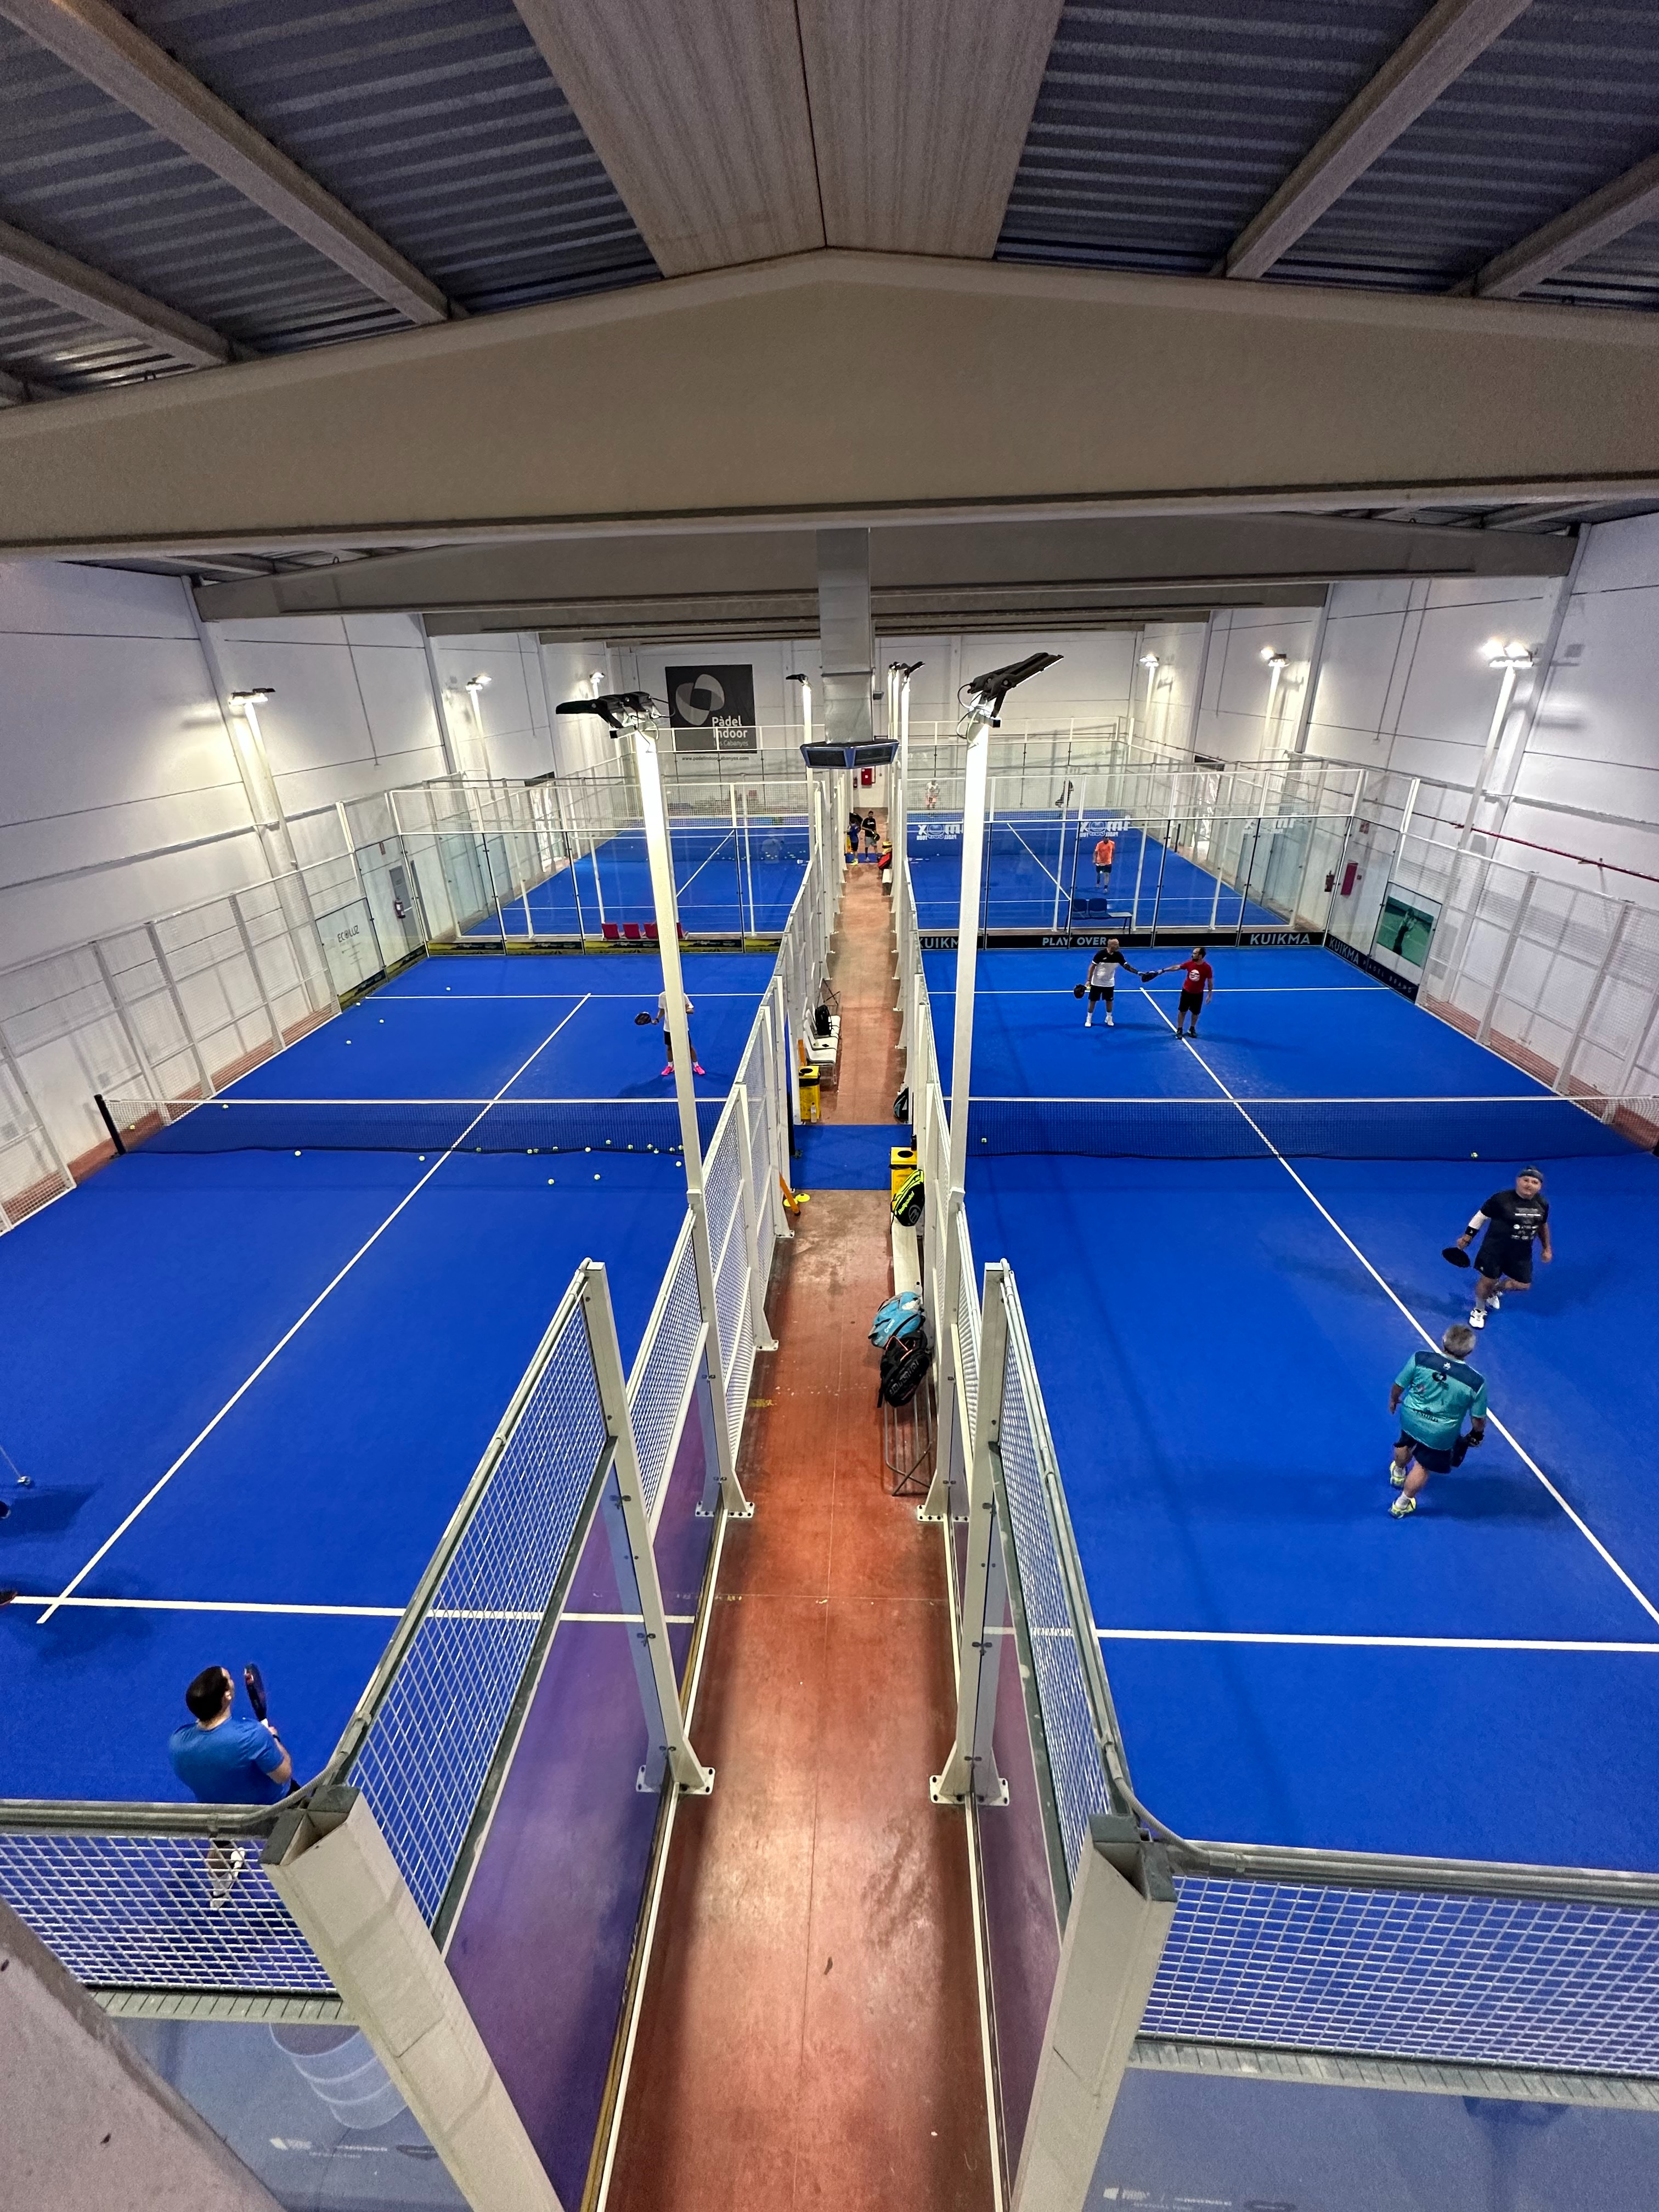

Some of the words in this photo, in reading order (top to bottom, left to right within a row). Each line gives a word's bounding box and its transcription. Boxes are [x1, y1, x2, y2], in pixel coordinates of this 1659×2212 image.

[712, 715, 742, 726] Pàdel
[713, 727, 748, 738] Indoor
[920, 938, 958, 949] KUIKM
[1042, 937, 1073, 945] PLAY
[1076, 937, 1107, 945] OVER
[1250, 933, 1310, 944] KUIKMA
[1329, 937, 1359, 964] KUIKMA
